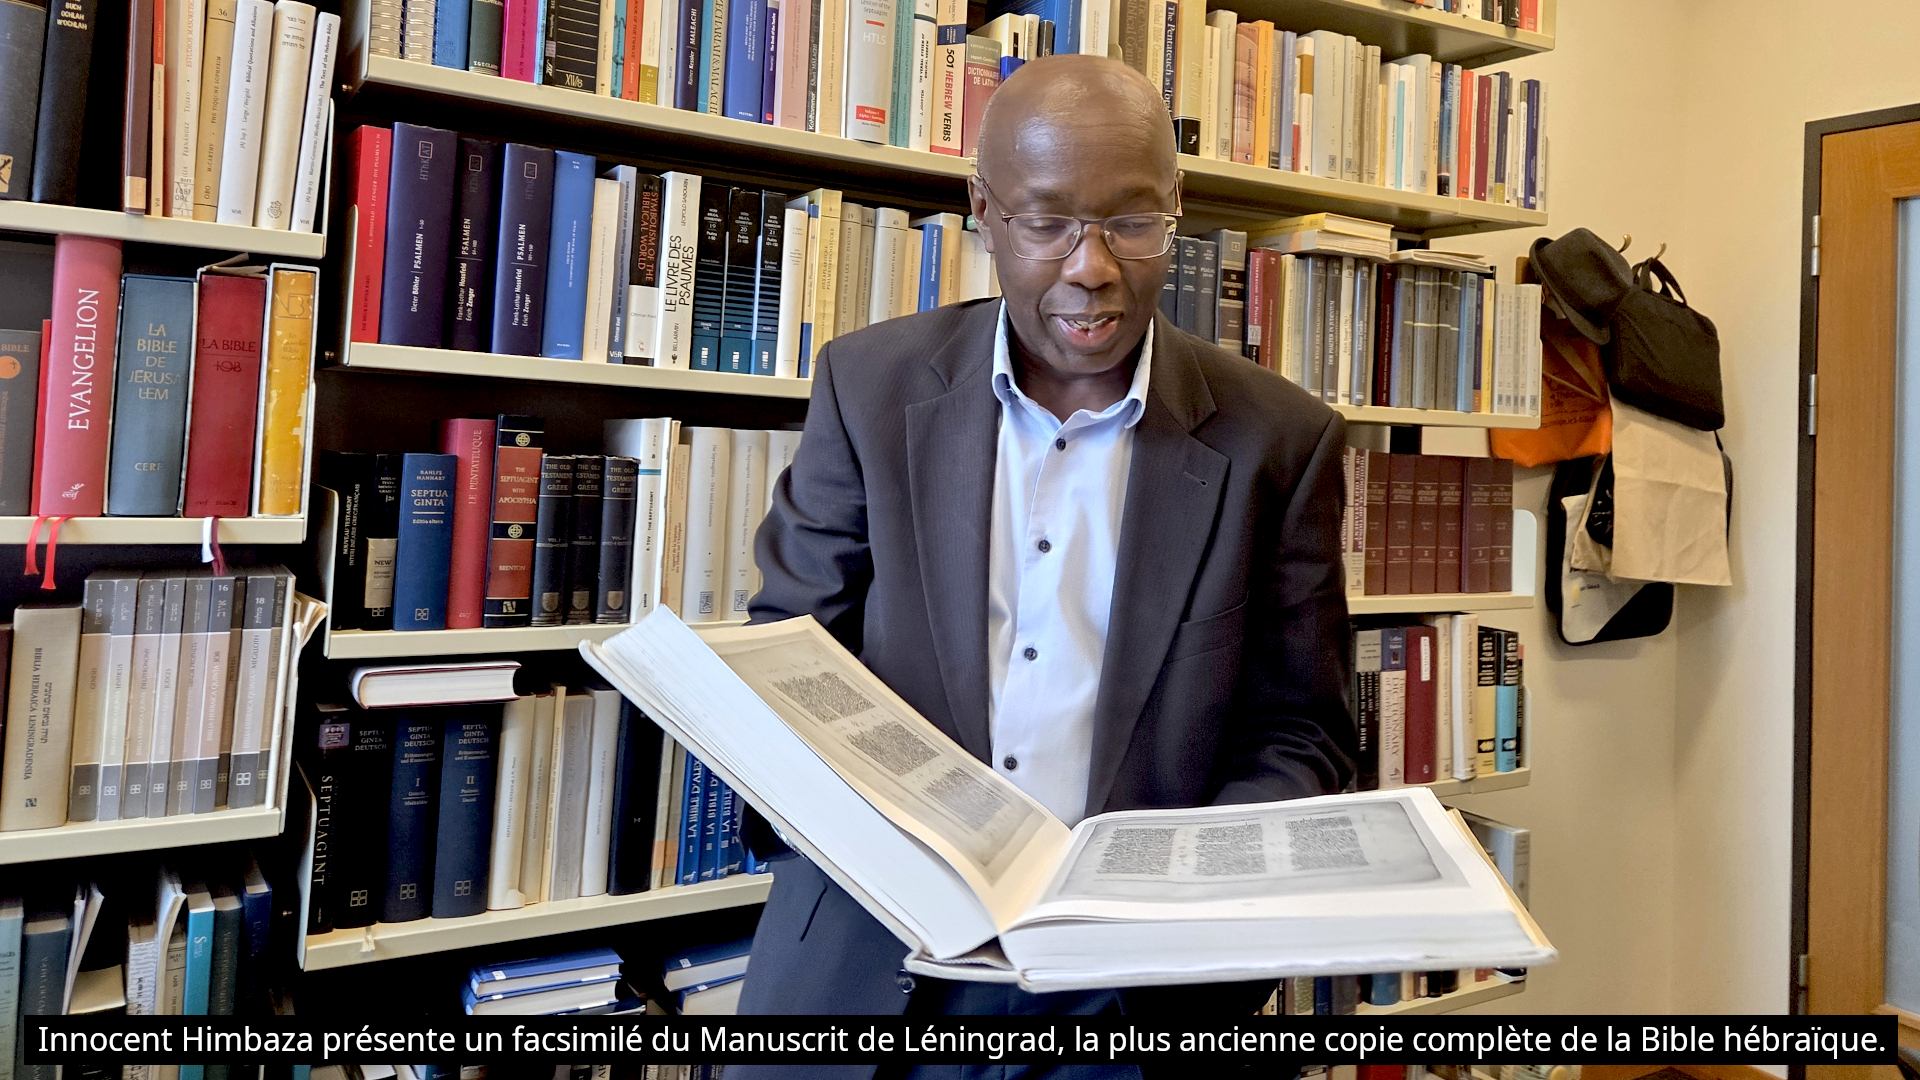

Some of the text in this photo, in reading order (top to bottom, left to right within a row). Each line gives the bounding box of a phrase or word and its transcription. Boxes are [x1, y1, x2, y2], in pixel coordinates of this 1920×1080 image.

[218, 9, 228, 17] 36
[863, 31, 886, 46] HTLS
[687, 8, 697, 85] Rainer Kessler MALEACHI
[967, 66, 1000, 78] DICTIONNAIRE
[973, 76, 981, 85] DE
[943, 48, 955, 142] 501 HEBREW VERBS
[808, 92, 816, 130] Kohlhammer
[461, 218, 471, 255] PSALMEN
[638, 191, 650, 270] BIBLICAL WORLD
[646, 192, 659, 281] SYMBOLISM OF THE
[459, 263, 467, 287] Hossfeld
[512, 223, 527, 326] Frank-Lothar Hossfeld PSALMEN
[665, 235, 682, 312] LE LIVRE DES
[679, 246, 694, 306] PSAUMES
[467, 288, 475, 308] Zenger
[523, 293, 531, 313] Zenger
[149, 323, 166, 337] LA
[136, 339, 178, 354] BIBLE
[201, 339, 256, 353] LA BIBLE
[68, 288, 100, 431] EVANGELION
[145, 356, 166, 368] DE
[138, 388, 168, 400] LEM
[134, 462, 163, 472] CERF
[468, 429, 483, 505] LE PENTATEUQUE
[500, 475, 539, 484] SEPTUAGINT
[411, 489, 448, 498] SEPTUA
[498, 496, 537, 505] APOCRYPHA
[413, 499, 445, 507] GINTA
[218, 584, 229, 592] 16
[255, 597, 265, 605] 18
[213, 651, 221, 663] JOB
[24, 648, 43, 780] BIBLIA HEBRAICA LENINGRADENSIA
[354, 743, 387, 751] DEUTSCH
[404, 739, 436, 747] DEUTSCH
[458, 737, 489, 745] DEUTSCH
[687, 759, 702, 838] LA BIBLE D'ALEX
[707, 790, 718, 818] BIBLE
[313, 775, 333, 886] SEPTUAGINT
[705, 822, 715, 835] LA
[721, 819, 730, 832] LA
